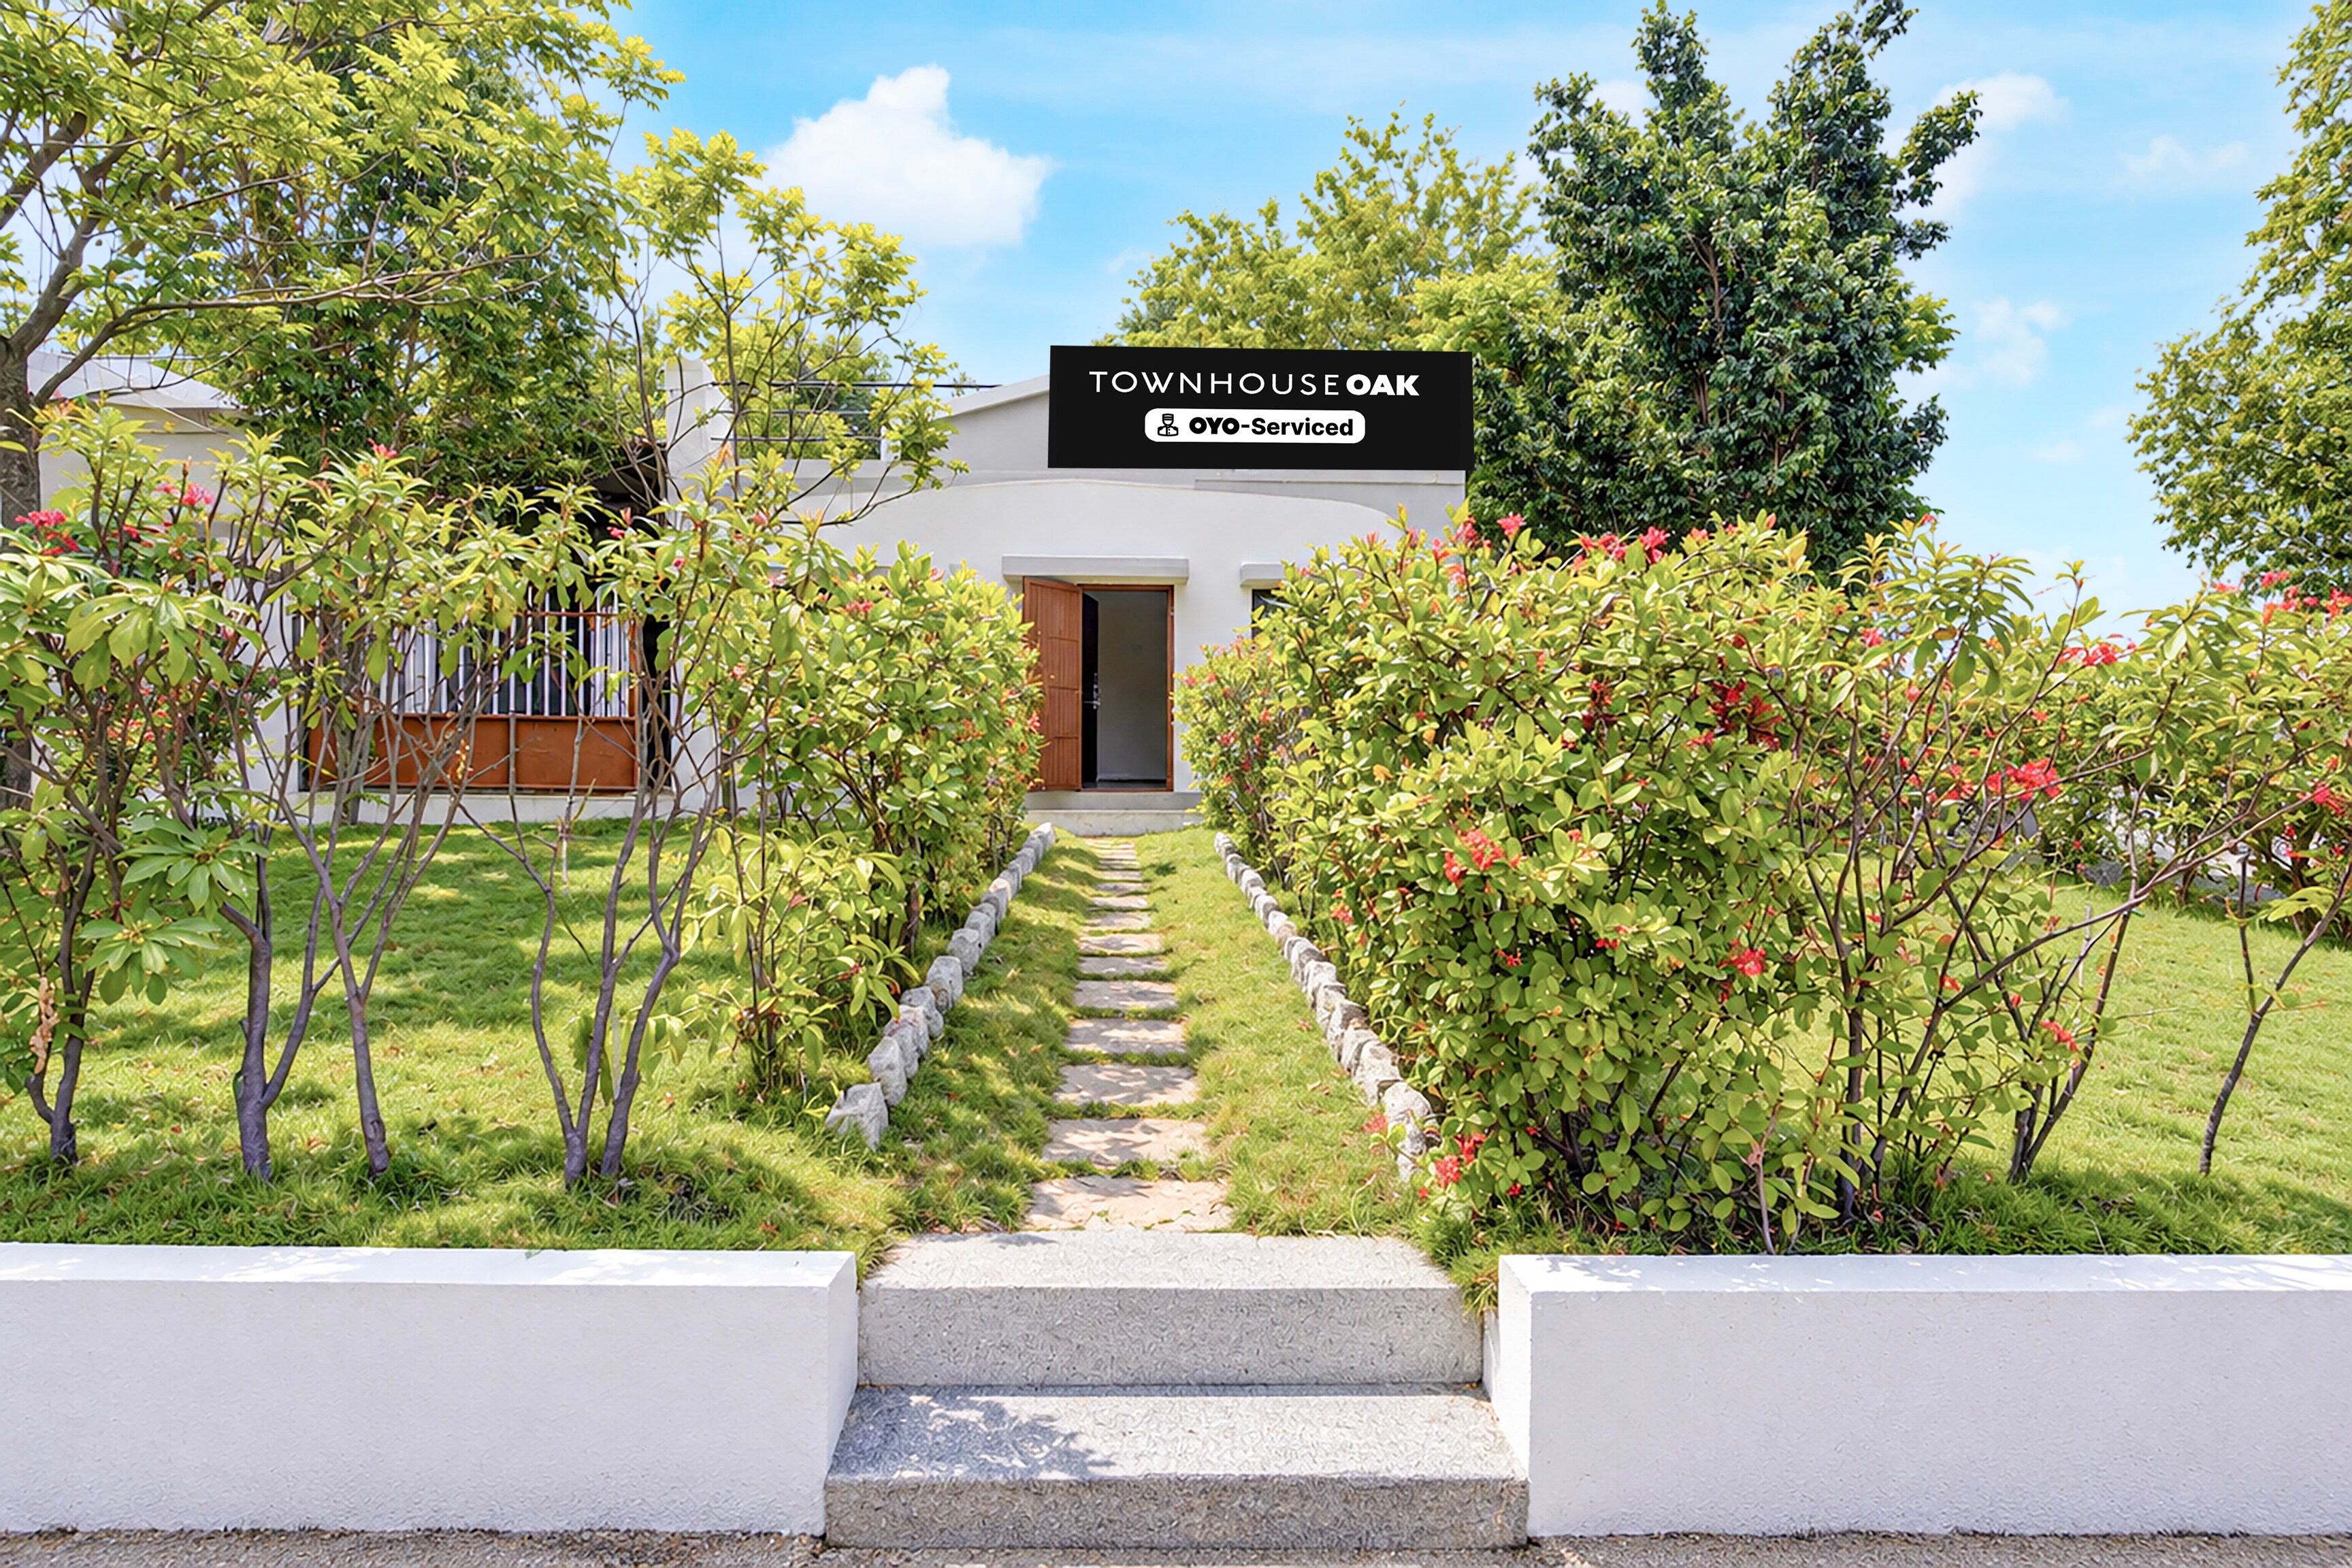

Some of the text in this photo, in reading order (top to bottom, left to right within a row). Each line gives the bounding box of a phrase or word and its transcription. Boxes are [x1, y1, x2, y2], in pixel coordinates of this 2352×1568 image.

[1089, 371, 1420, 397] TOWNHOUSE OAK
[1189, 416, 1353, 436] OYO-Serviced
